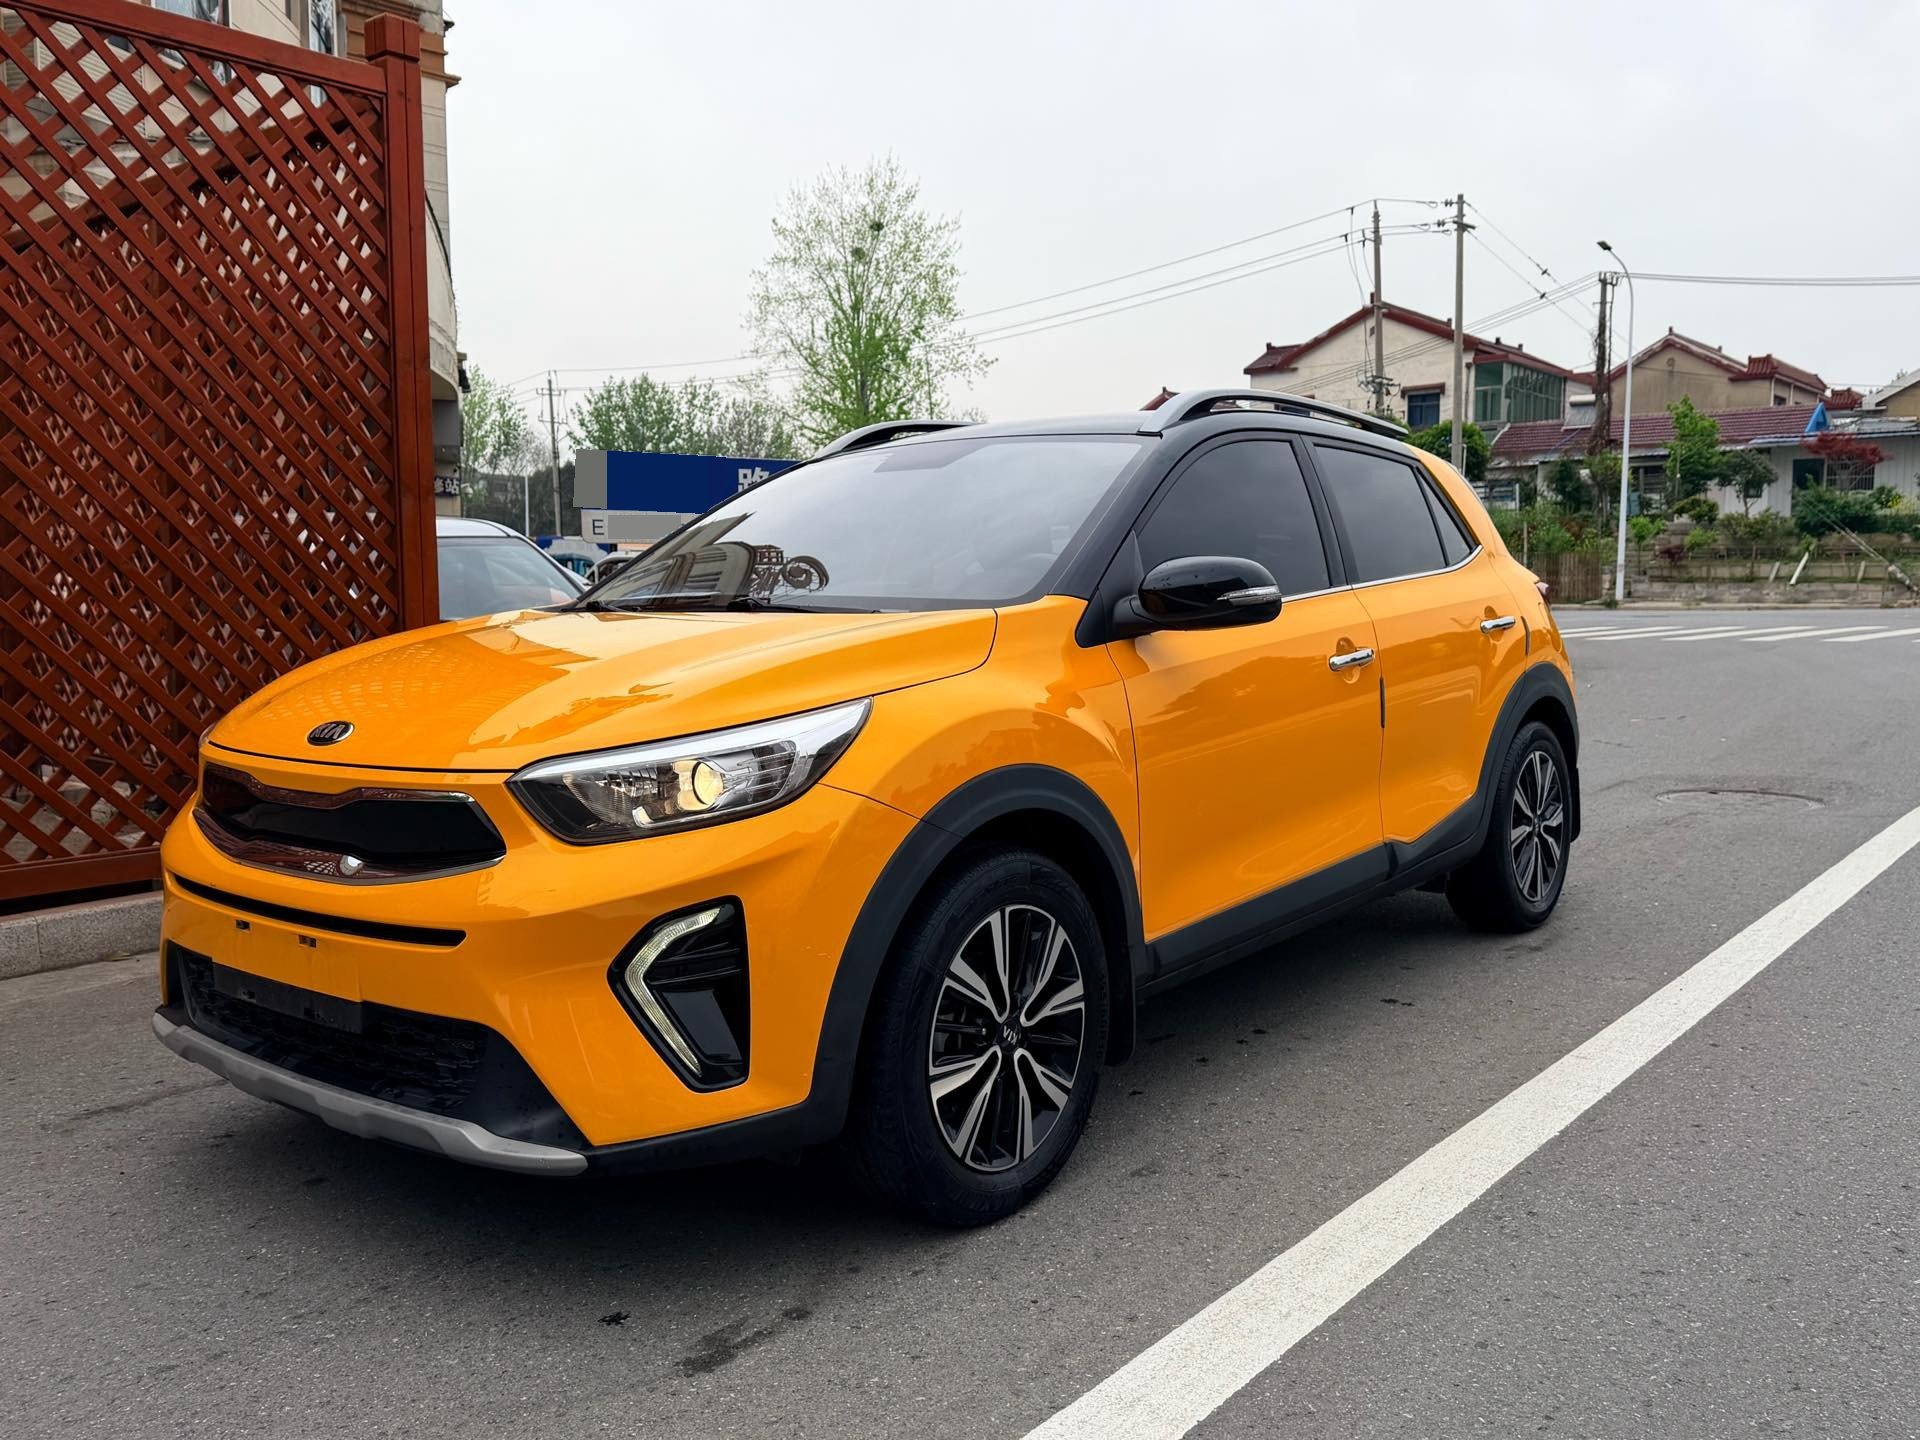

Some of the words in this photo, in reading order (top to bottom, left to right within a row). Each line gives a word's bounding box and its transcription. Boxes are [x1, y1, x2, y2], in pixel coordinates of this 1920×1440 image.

[592, 519, 604, 535] E
[310, 723, 346, 739] KIA
[1003, 1025, 1018, 1046] KIA
